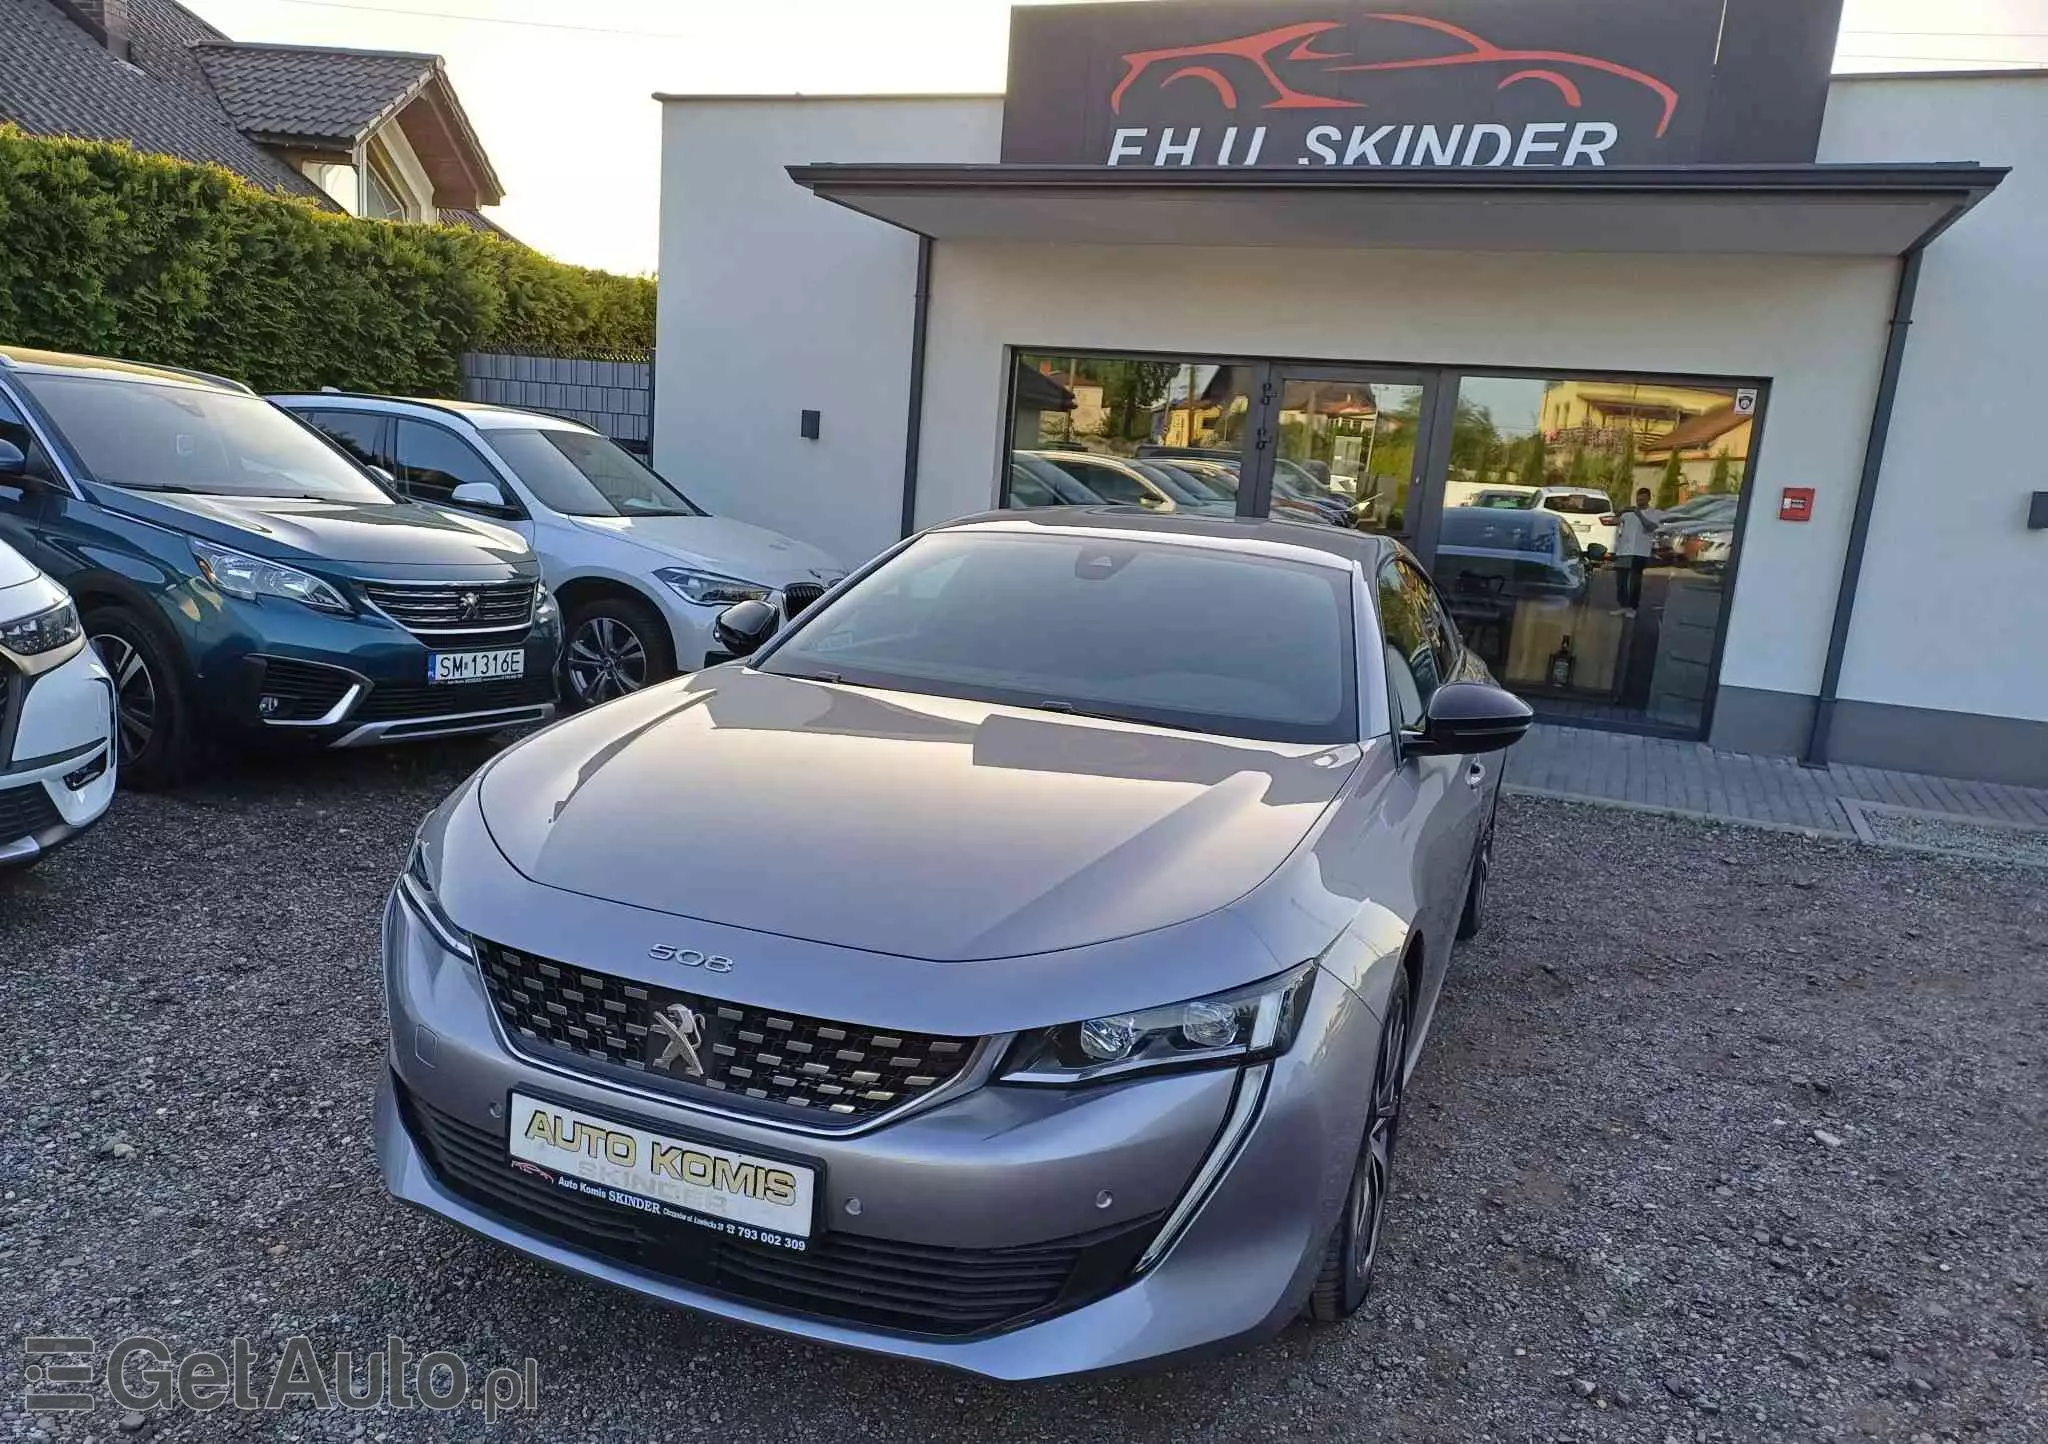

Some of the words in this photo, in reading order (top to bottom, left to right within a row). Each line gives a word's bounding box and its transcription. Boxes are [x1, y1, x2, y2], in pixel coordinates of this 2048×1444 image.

[1298, 122, 1618, 166] SKINDER
[440, 655, 463, 678] SM
[472, 651, 521, 675] 1316E
[648, 943, 733, 973] 508
[525, 1109, 637, 1168] AUTO
[651, 1141, 796, 1206] KOMIS
[558, 1175, 578, 1190] Auto
[580, 1182, 606, 1198] Komis
[608, 1190, 661, 1214] SKINDER
[738, 1226, 758, 1240] 793
[761, 1232, 781, 1246] 002
[784, 1237, 805, 1251] 309
